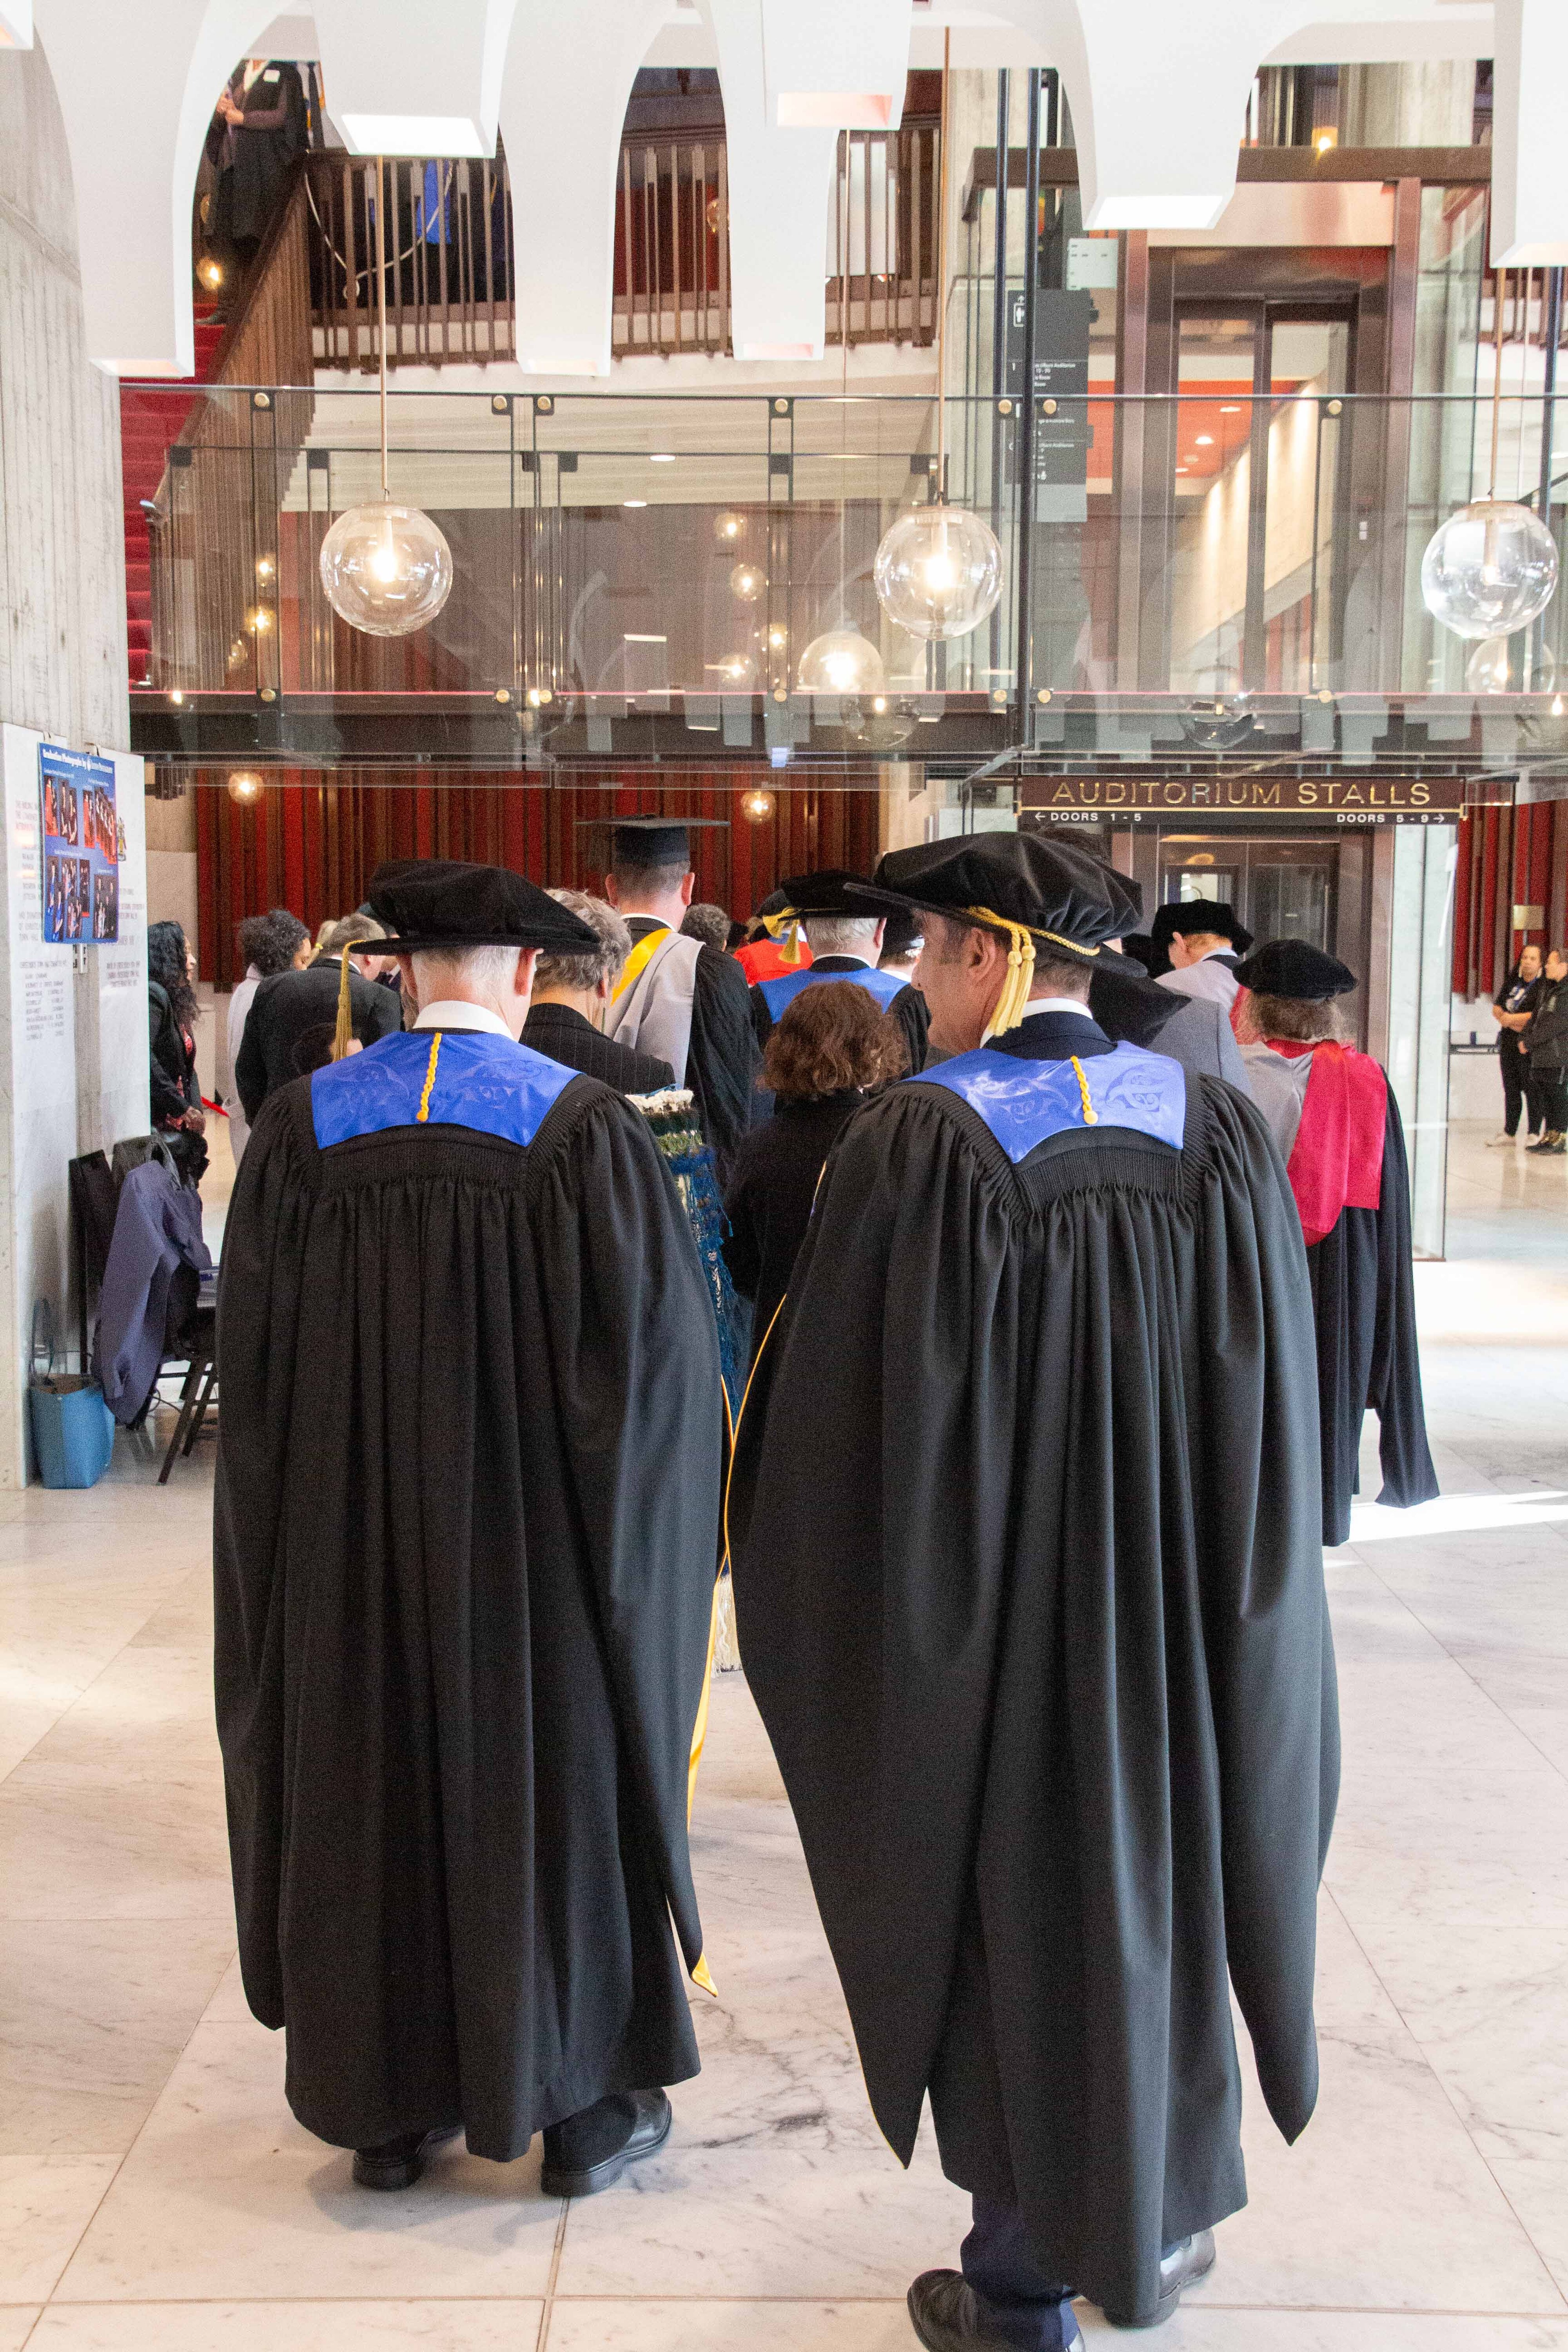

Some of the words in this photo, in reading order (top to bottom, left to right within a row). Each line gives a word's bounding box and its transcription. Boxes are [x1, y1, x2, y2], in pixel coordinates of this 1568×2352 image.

[1052, 782, 1280, 804] AUDITORIUM
[1297, 782, 1431, 805] STALLS
[1051, 813, 1098, 822] DOORS
[1134, 813, 1142, 822] 5
[1337, 813, 1386, 823] DOORS
[1396, 814, 1404, 823] 5
[1421, 814, 1429, 823] 9
